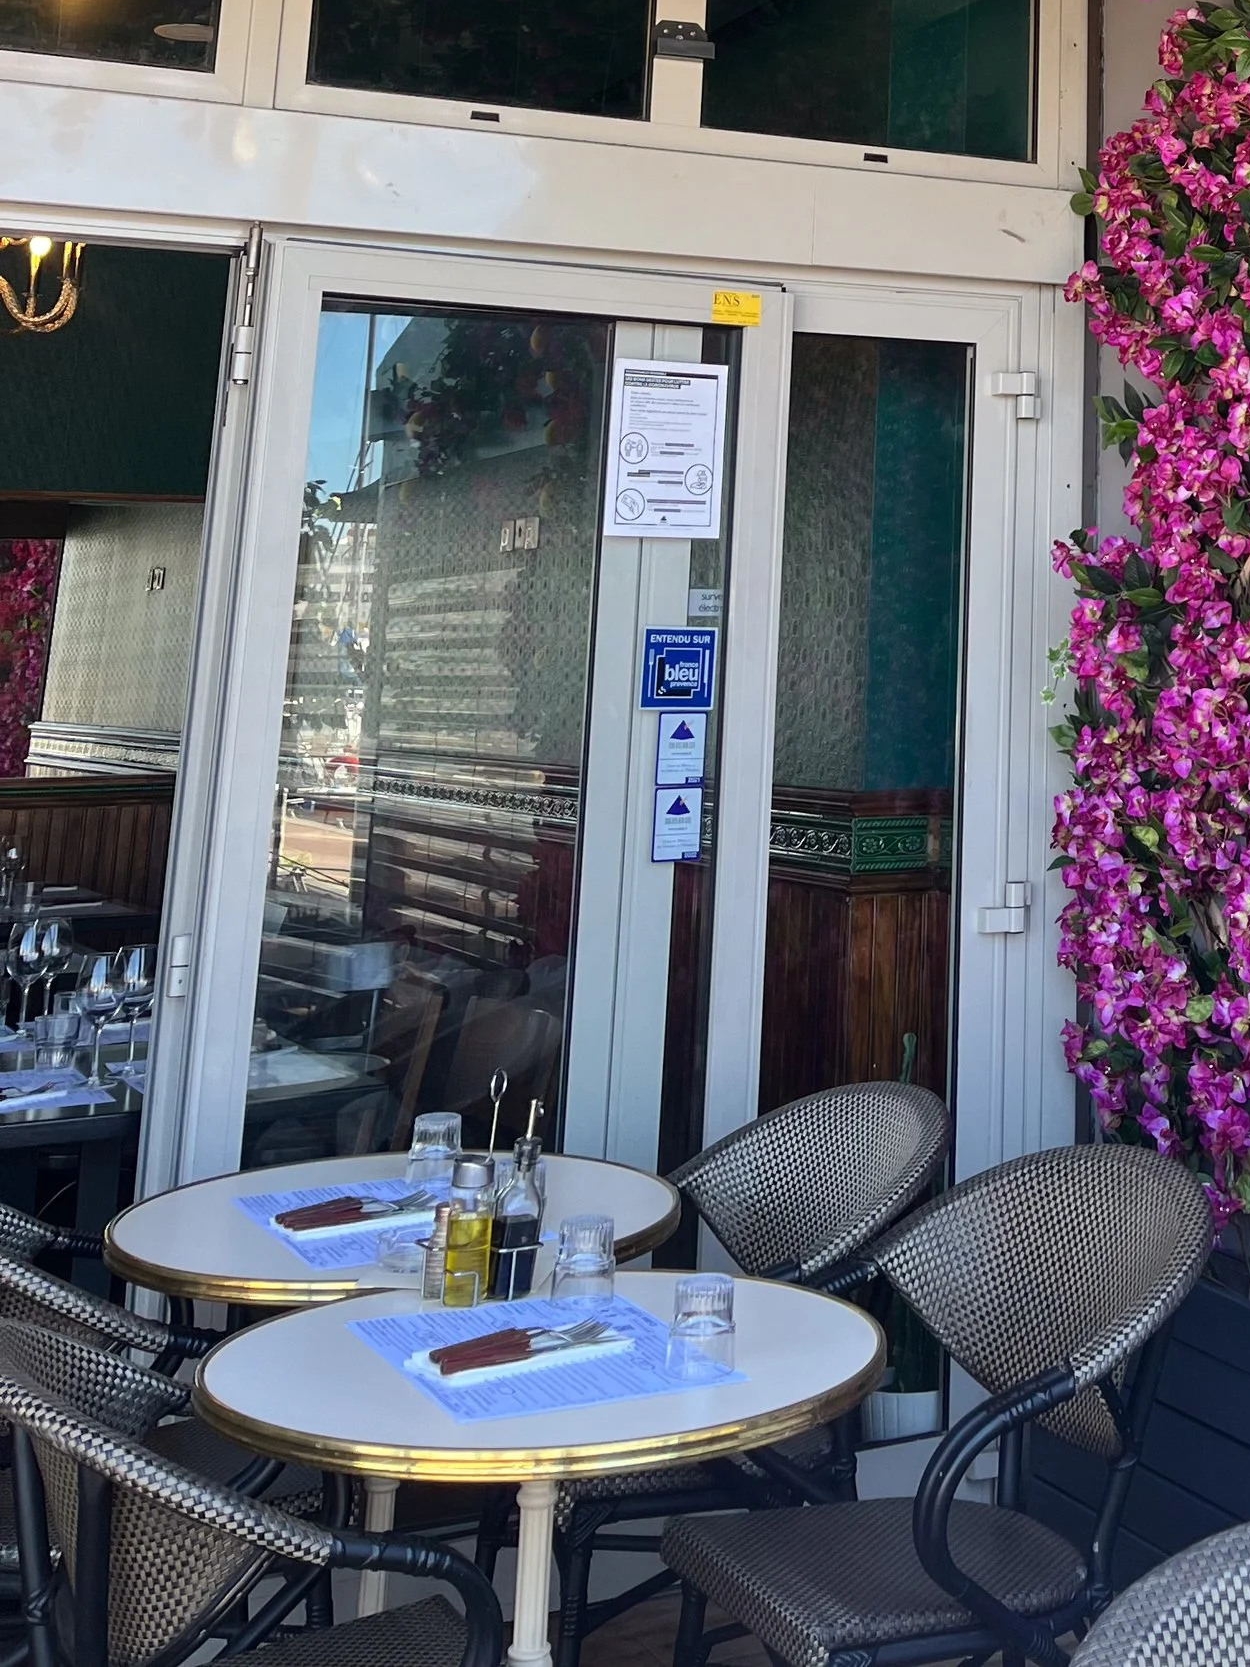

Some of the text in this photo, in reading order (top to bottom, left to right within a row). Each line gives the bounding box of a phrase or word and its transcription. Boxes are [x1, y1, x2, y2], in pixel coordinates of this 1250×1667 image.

[713, 293, 741, 307] ENS
[650, 634, 711, 644] ENTENDU SUR
[664, 663, 699, 681] bleu
